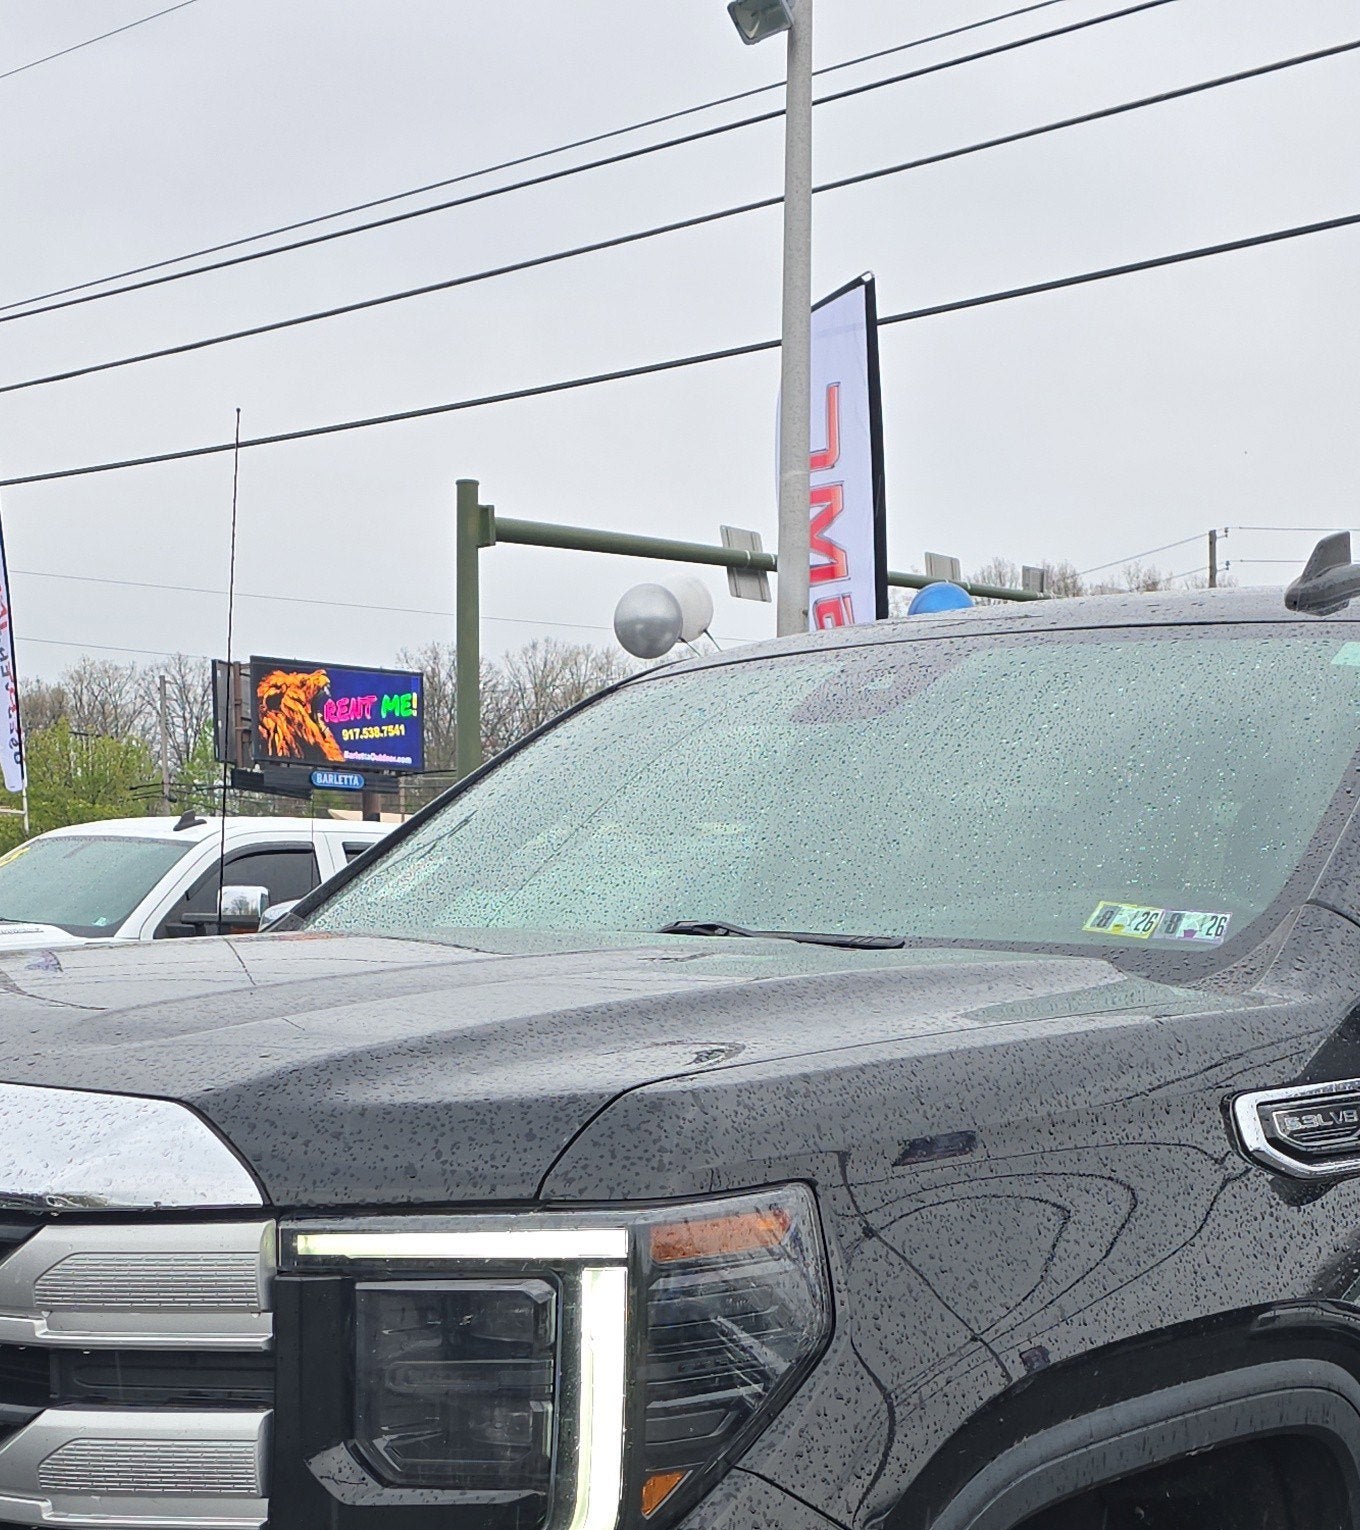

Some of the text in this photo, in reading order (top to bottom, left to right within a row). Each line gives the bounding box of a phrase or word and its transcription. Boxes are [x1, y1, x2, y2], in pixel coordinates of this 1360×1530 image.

[324, 692, 417, 722] RENT ME!
[316, 773, 359, 786] BARLETTA
[1134, 911, 1159, 932] 26
[1206, 915, 1227, 937] 26
[1330, 1109, 1358, 1124] V8
